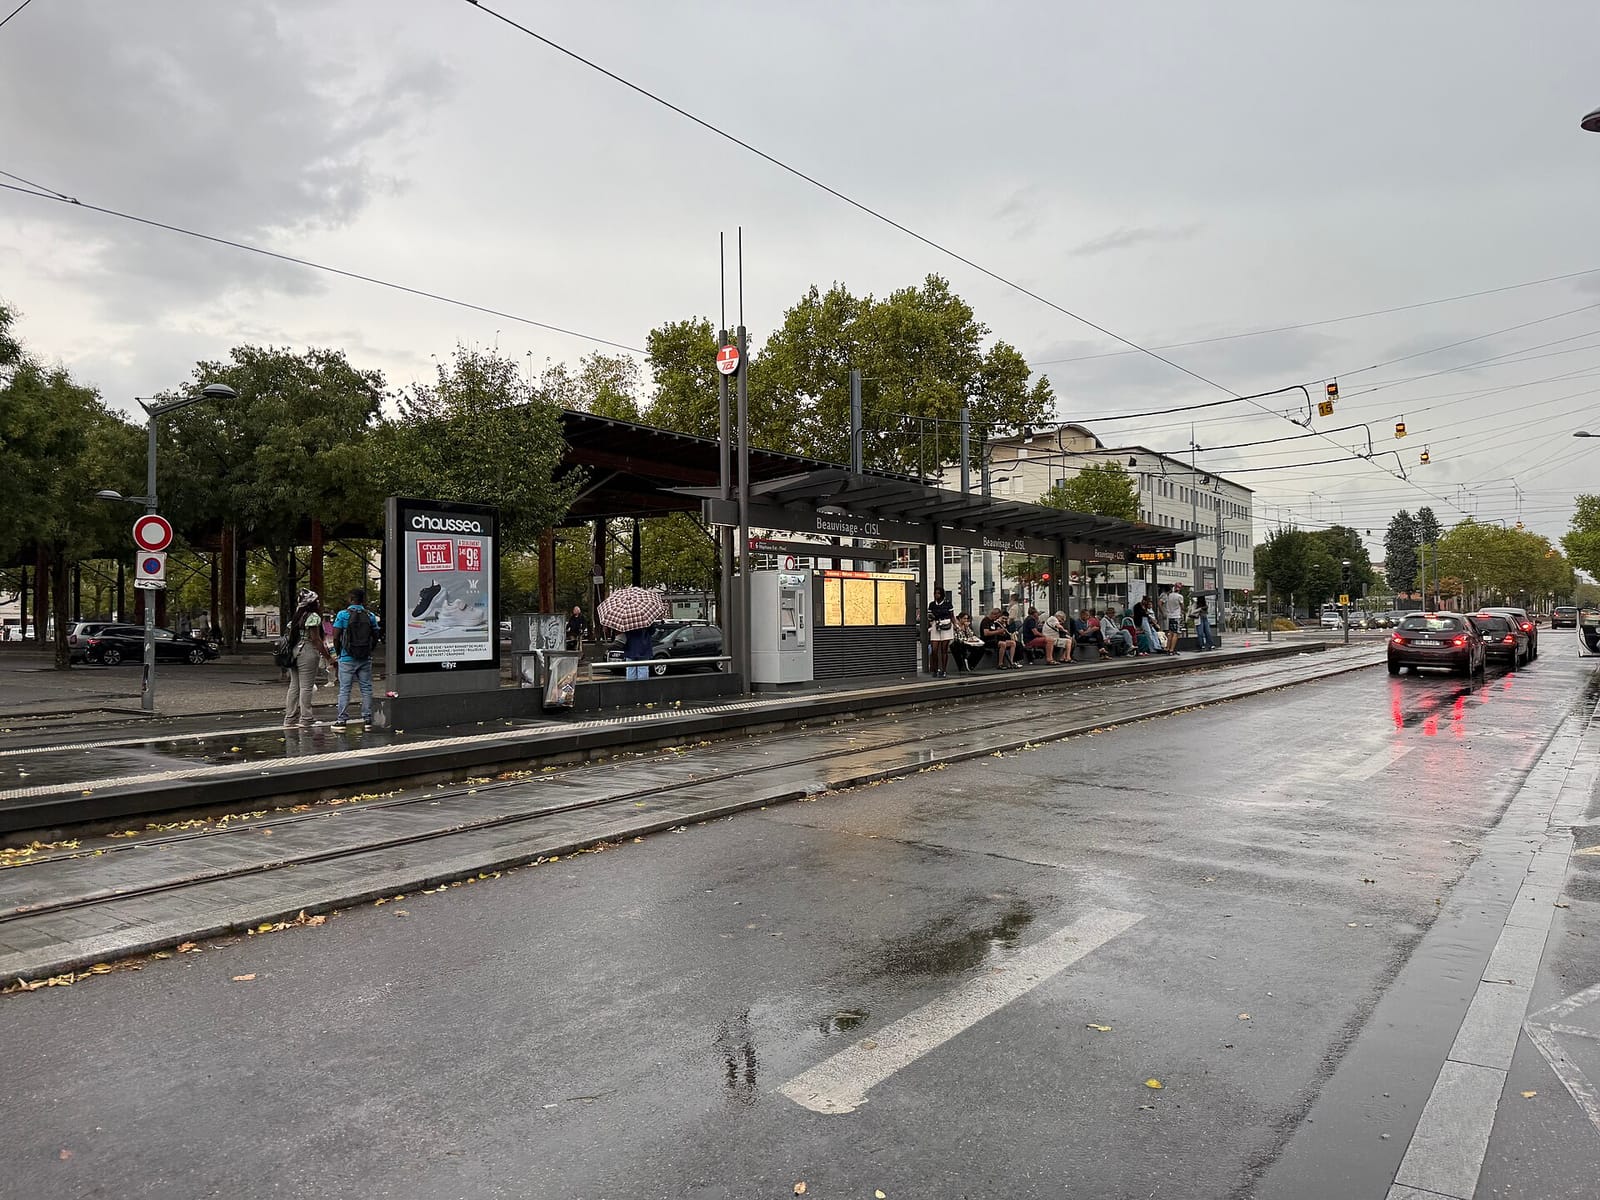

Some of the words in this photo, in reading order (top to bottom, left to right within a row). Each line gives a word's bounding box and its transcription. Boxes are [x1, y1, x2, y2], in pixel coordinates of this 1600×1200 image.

[722, 347, 733, 359] T
[721, 360, 735, 371] TCL
[1319, 403, 1333, 415] 15
[816, 517, 858, 536] Beauvisage
[864, 522, 880, 536] CISL
[983, 536, 1011, 551] Beauvisage
[1014, 539, 1026, 551] CISL
[426, 551, 446, 564] DEAL
